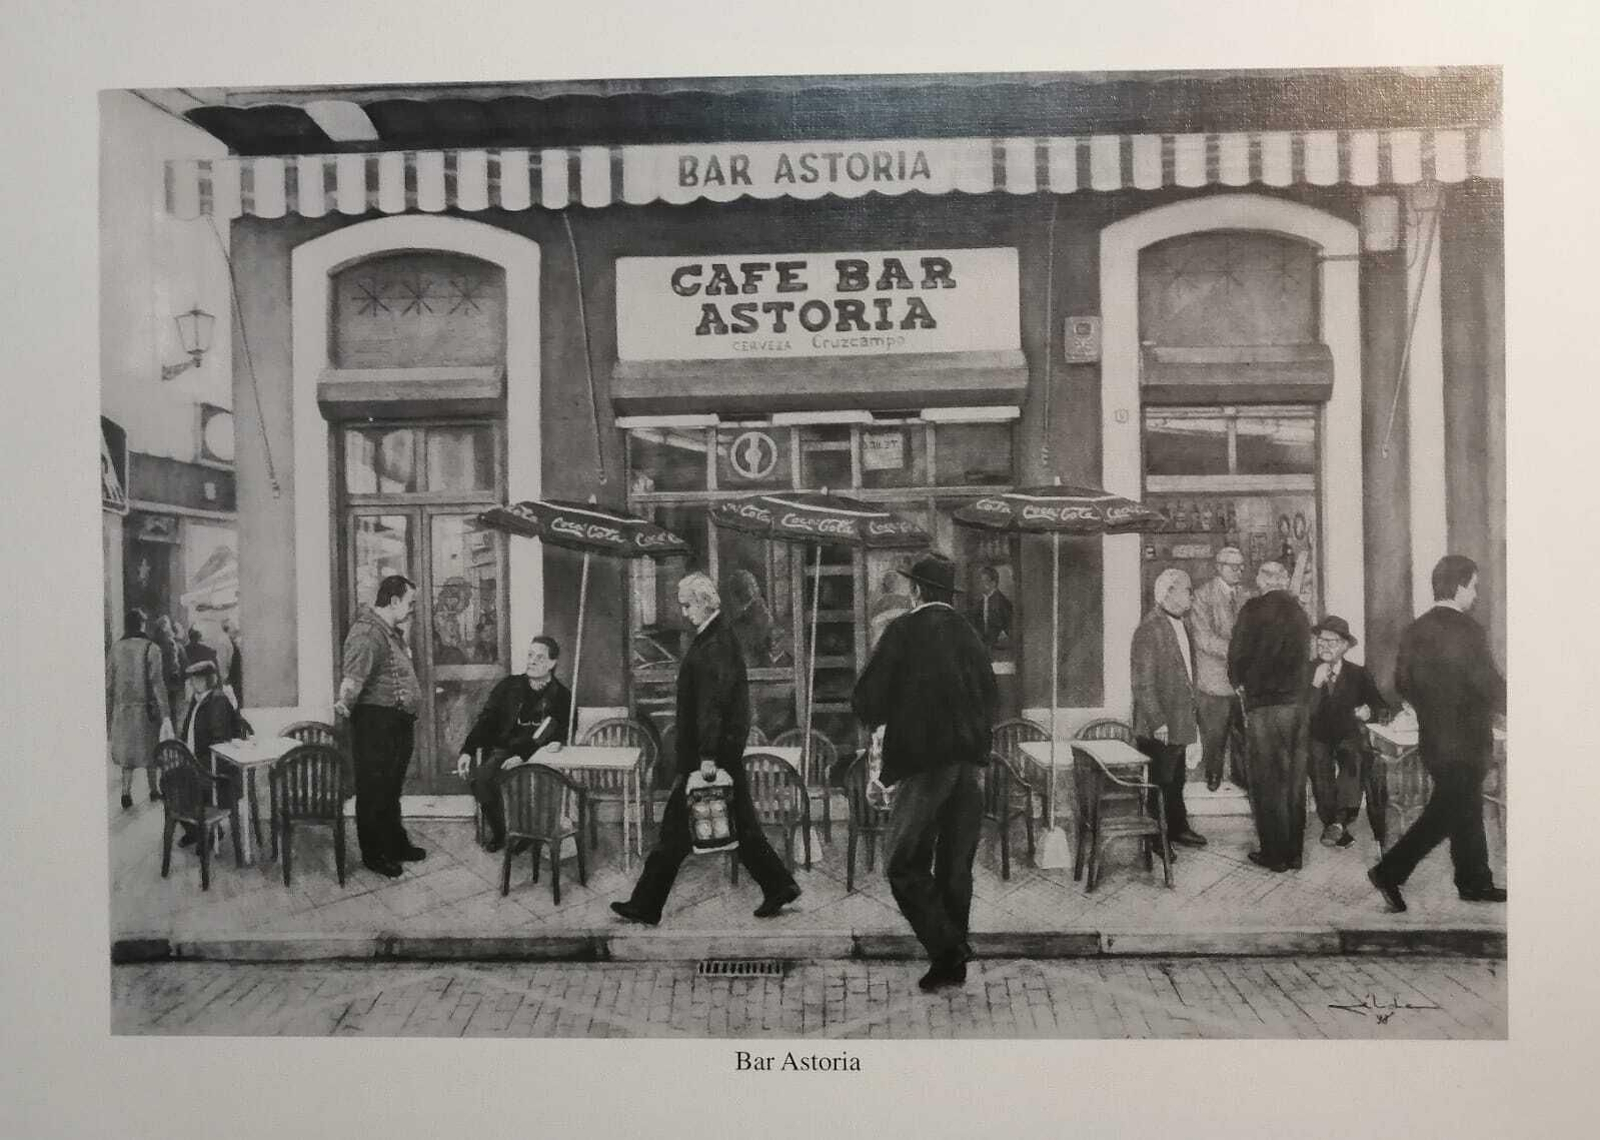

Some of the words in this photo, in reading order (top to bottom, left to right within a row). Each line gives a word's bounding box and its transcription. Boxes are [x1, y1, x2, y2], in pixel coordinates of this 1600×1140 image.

[678, 154, 753, 188] BAR
[774, 150, 932, 185] ASTORIA
[670, 260, 809, 297] CAFE
[835, 256, 957, 292] BAR
[695, 297, 937, 336] ASTORIA
[732, 340, 792, 352] CERVEZA
[812, 334, 905, 350] Cruzcampo
[736, 1051, 775, 1071] Bar
[781, 1050, 861, 1071] Astoria
